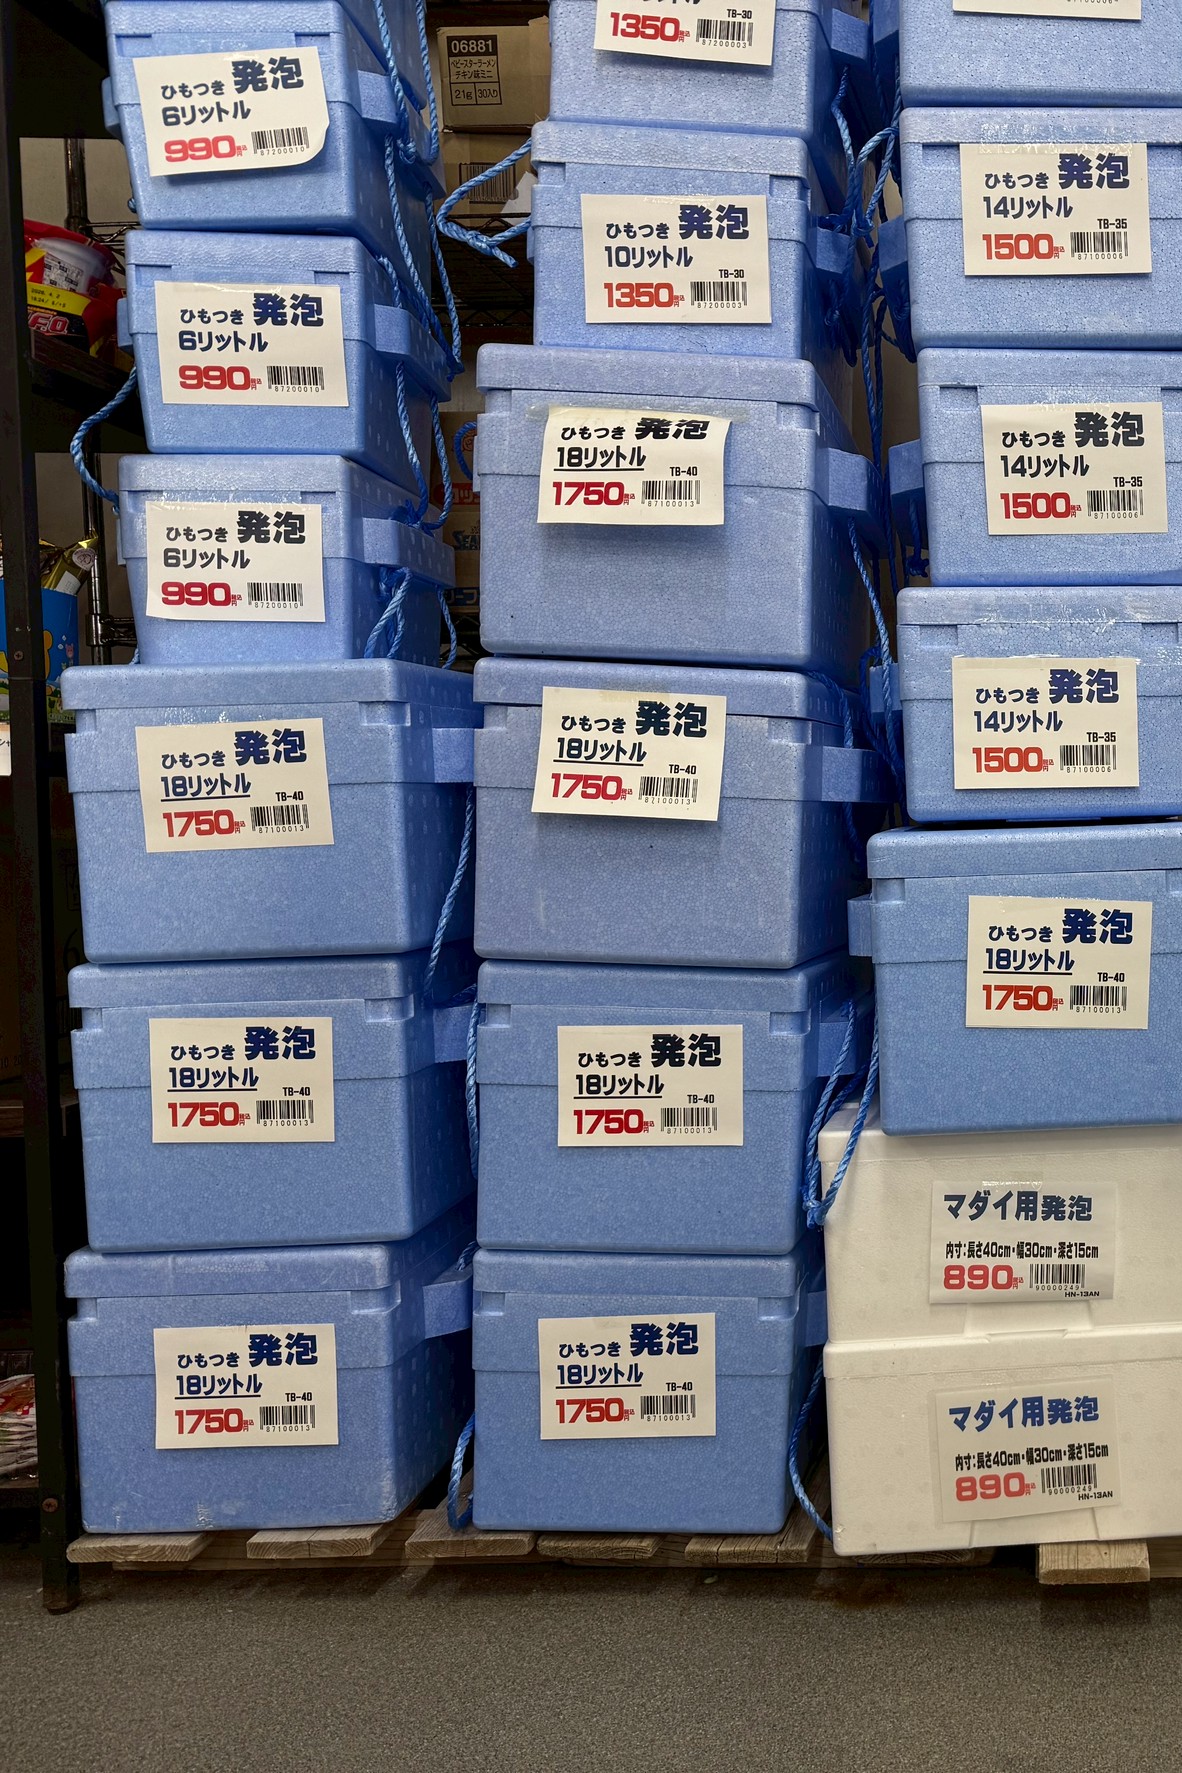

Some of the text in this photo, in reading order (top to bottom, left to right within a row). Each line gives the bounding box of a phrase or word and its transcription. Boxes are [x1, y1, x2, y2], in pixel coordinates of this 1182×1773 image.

[610, 12, 681, 42] 1350
[727, 9, 752, 19] TB-30
[451, 39, 494, 53] 06881
[161, 57, 304, 99] ひもつき 発泡
[455, 69, 493, 80] チキン味ミニ
[455, 89, 473, 100] 21g
[162, 100, 251, 126] 6リットル
[164, 135, 236, 162] 990
[985, 153, 1130, 190] ひもつき 発泡
[983, 196, 1073, 219] 14リットル
[606, 204, 749, 240] ひもつき 発泡
[1097, 218, 1128, 230] TB-35
[605, 246, 693, 268] 10リットル
[982, 233, 1054, 260] 1500
[603, 282, 675, 308] 1350
[180, 293, 324, 326] ひもつき 発泡
[179, 330, 269, 352] 6リットル
[178, 365, 251, 390] 990
[560, 417, 710, 440] ひもつき 発泡
[1002, 411, 1145, 448] ひもつき 発泡
[556, 446, 646, 468] 18リットル
[1000, 455, 1090, 478] 14リットル
[552, 481, 625, 507] 1750
[1000, 492, 1071, 520] 1500
[166, 510, 306, 544] ひもつき 発泡
[163, 547, 250, 569] 6リットル
[161, 581, 231, 607] 990
[975, 668, 1119, 704] ひもつき 発泡
[561, 701, 708, 738] ひもつき 発泡
[973, 710, 1063, 733] 14リットル
[161, 728, 307, 769] ひもつき 発泡
[556, 737, 647, 763] 18リットル
[972, 746, 1043, 773] 1500
[160, 773, 251, 797] 18リットル
[275, 790, 304, 802] TB-40
[551, 773, 623, 801] 1750
[162, 809, 236, 838] 1750
[988, 908, 1133, 945] ひもつき 発泡
[986, 948, 1075, 971] 18リットル
[982, 984, 1053, 1011] 1750
[170, 1025, 316, 1061] ひもつき 発泡
[578, 1033, 721, 1068] ひもつき 発泡
[168, 1066, 259, 1089] 18リットル
[575, 1073, 665, 1096] 18リットル
[168, 1101, 240, 1128] 1750
[573, 1108, 644, 1135] 1750
[943, 1190, 1093, 1222] マダイ用発泡
[943, 1264, 1014, 1290] 890
[177, 1332, 318, 1369] ひもつき 発泡
[558, 1323, 699, 1359] ひもつき 発泡
[176, 1373, 263, 1396] 18リットル
[556, 1362, 643, 1385] 18リットル
[174, 1407, 244, 1435] 1750
[555, 1397, 625, 1424] 1750
[948, 1395, 1100, 1432] マダイ用発泡
[955, 1472, 1026, 1502] 890
